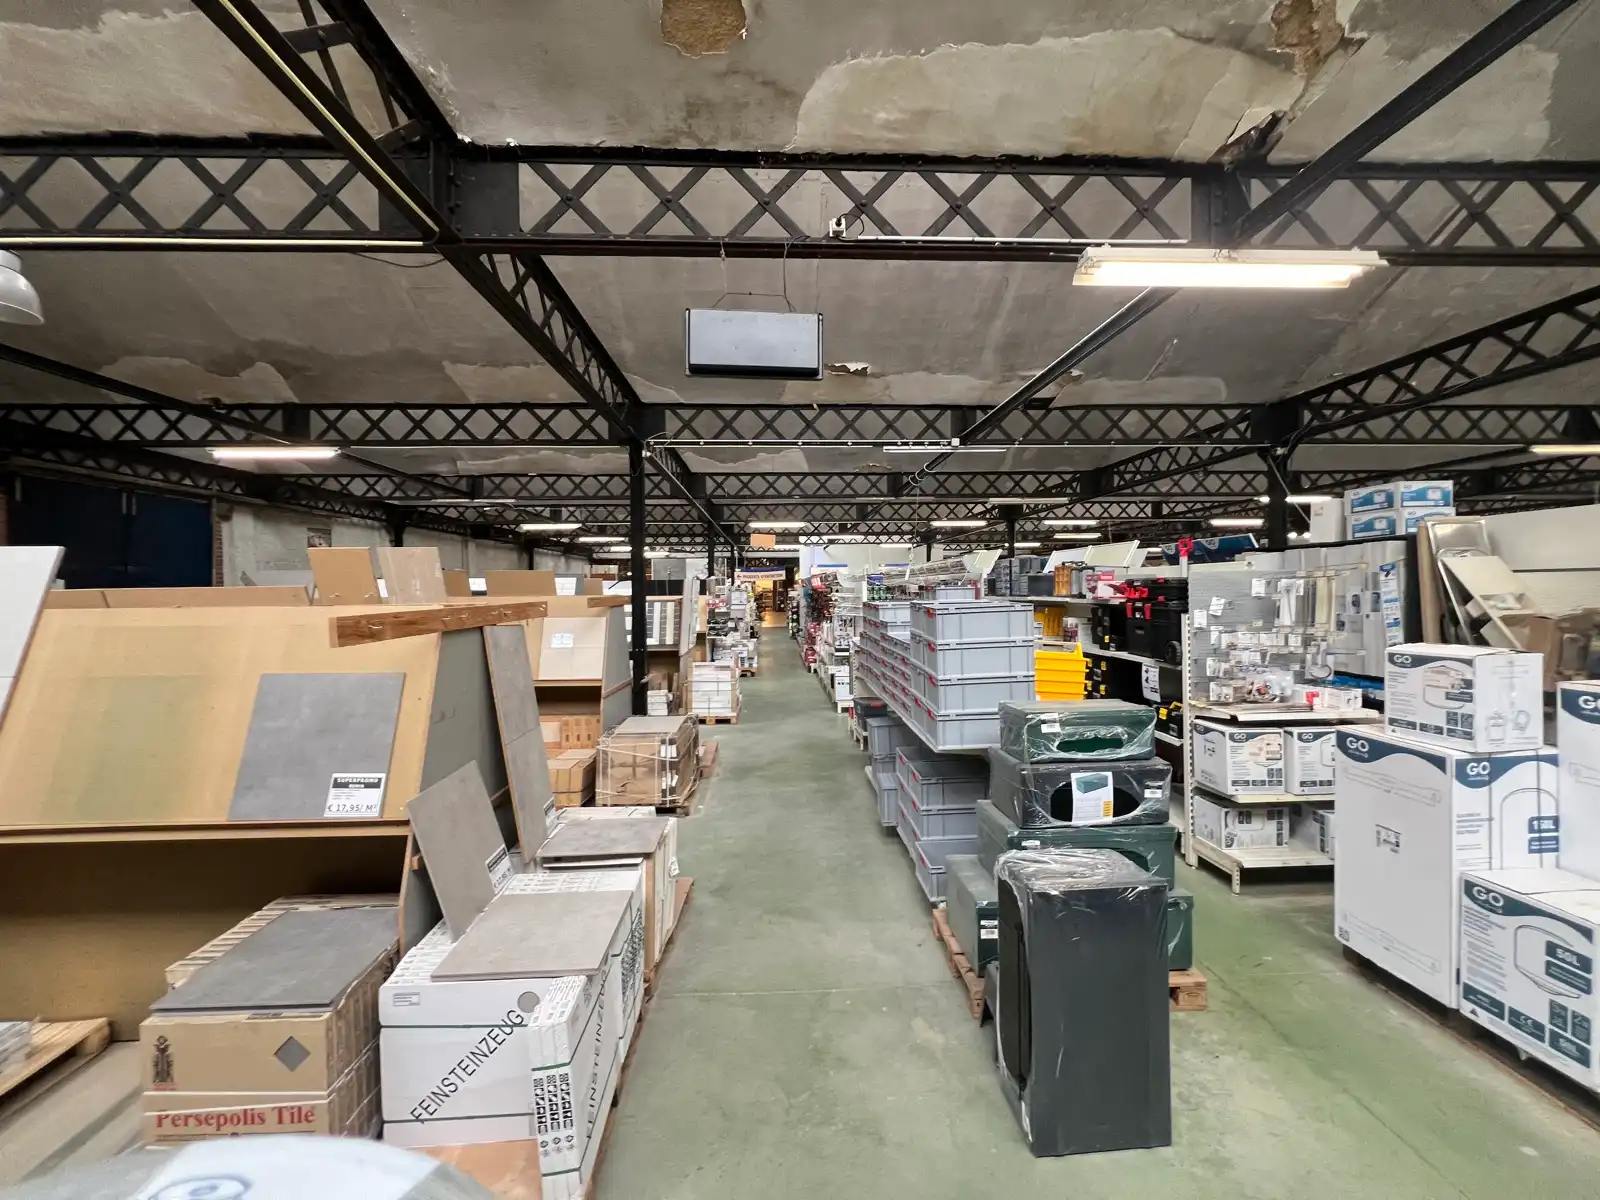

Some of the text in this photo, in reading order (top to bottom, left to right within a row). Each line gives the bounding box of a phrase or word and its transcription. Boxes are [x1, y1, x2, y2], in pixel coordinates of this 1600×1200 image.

[1393, 654, 1412, 664] GO
[1578, 695, 1600, 709] G
[1346, 737, 1370, 752] GO
[1466, 761, 1491, 776] GO
[1472, 886, 1504, 907] GO
[410, 1009, 525, 1124] FEINSTEINZEUG
[156, 1105, 315, 1132] Persepolis Tile
